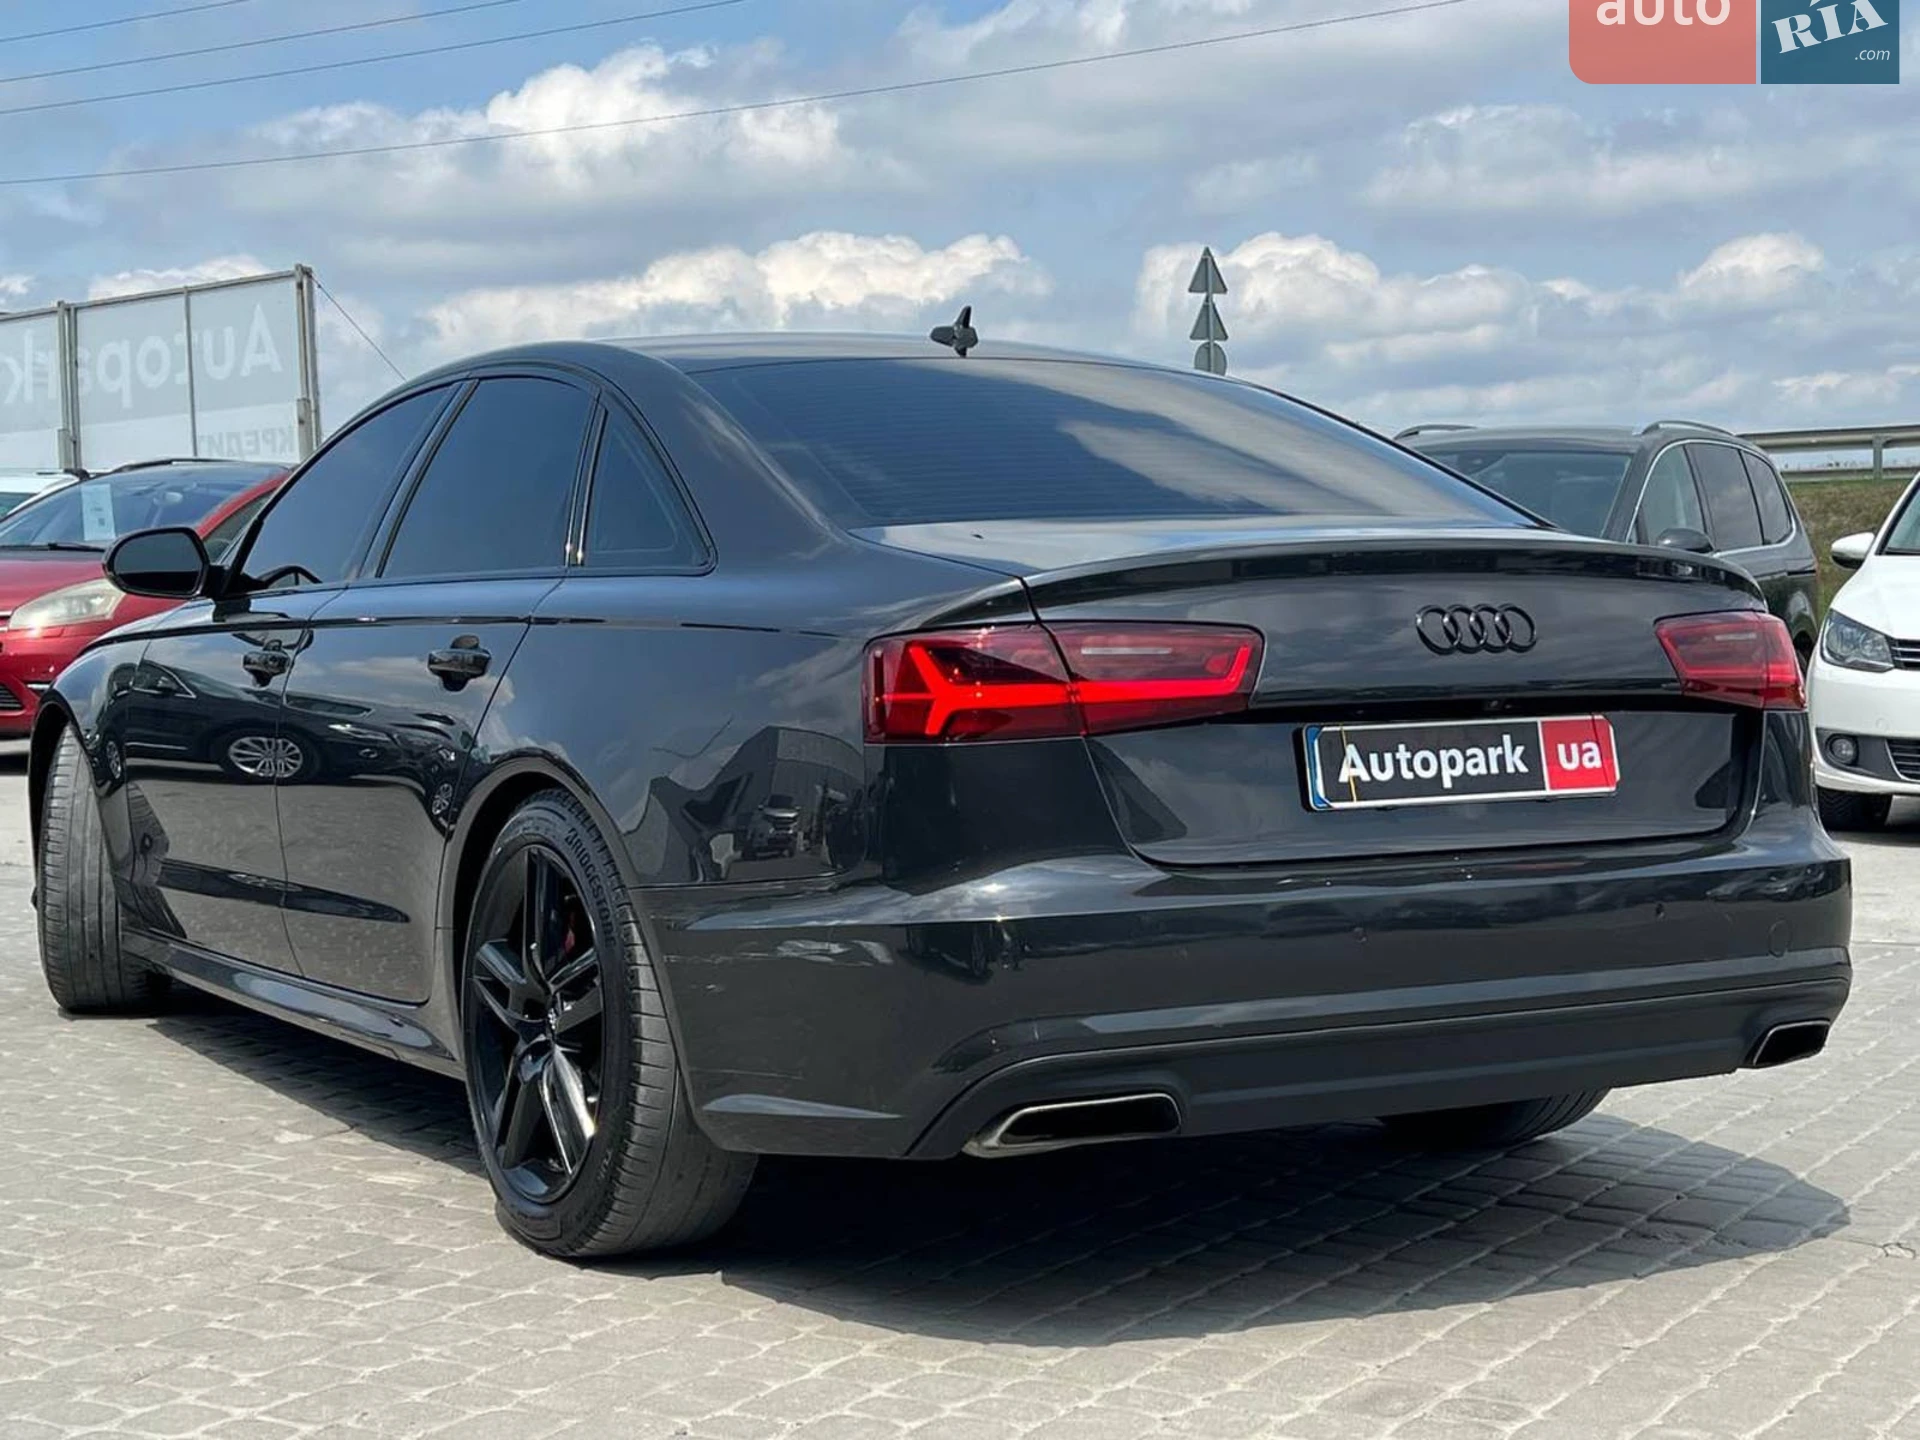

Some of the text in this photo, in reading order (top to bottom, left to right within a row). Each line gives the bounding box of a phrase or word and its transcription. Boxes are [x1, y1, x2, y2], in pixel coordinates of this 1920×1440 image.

[1338, 734, 1602, 788] Autopark ua
[564, 827, 617, 949] BRIDGESTONE
